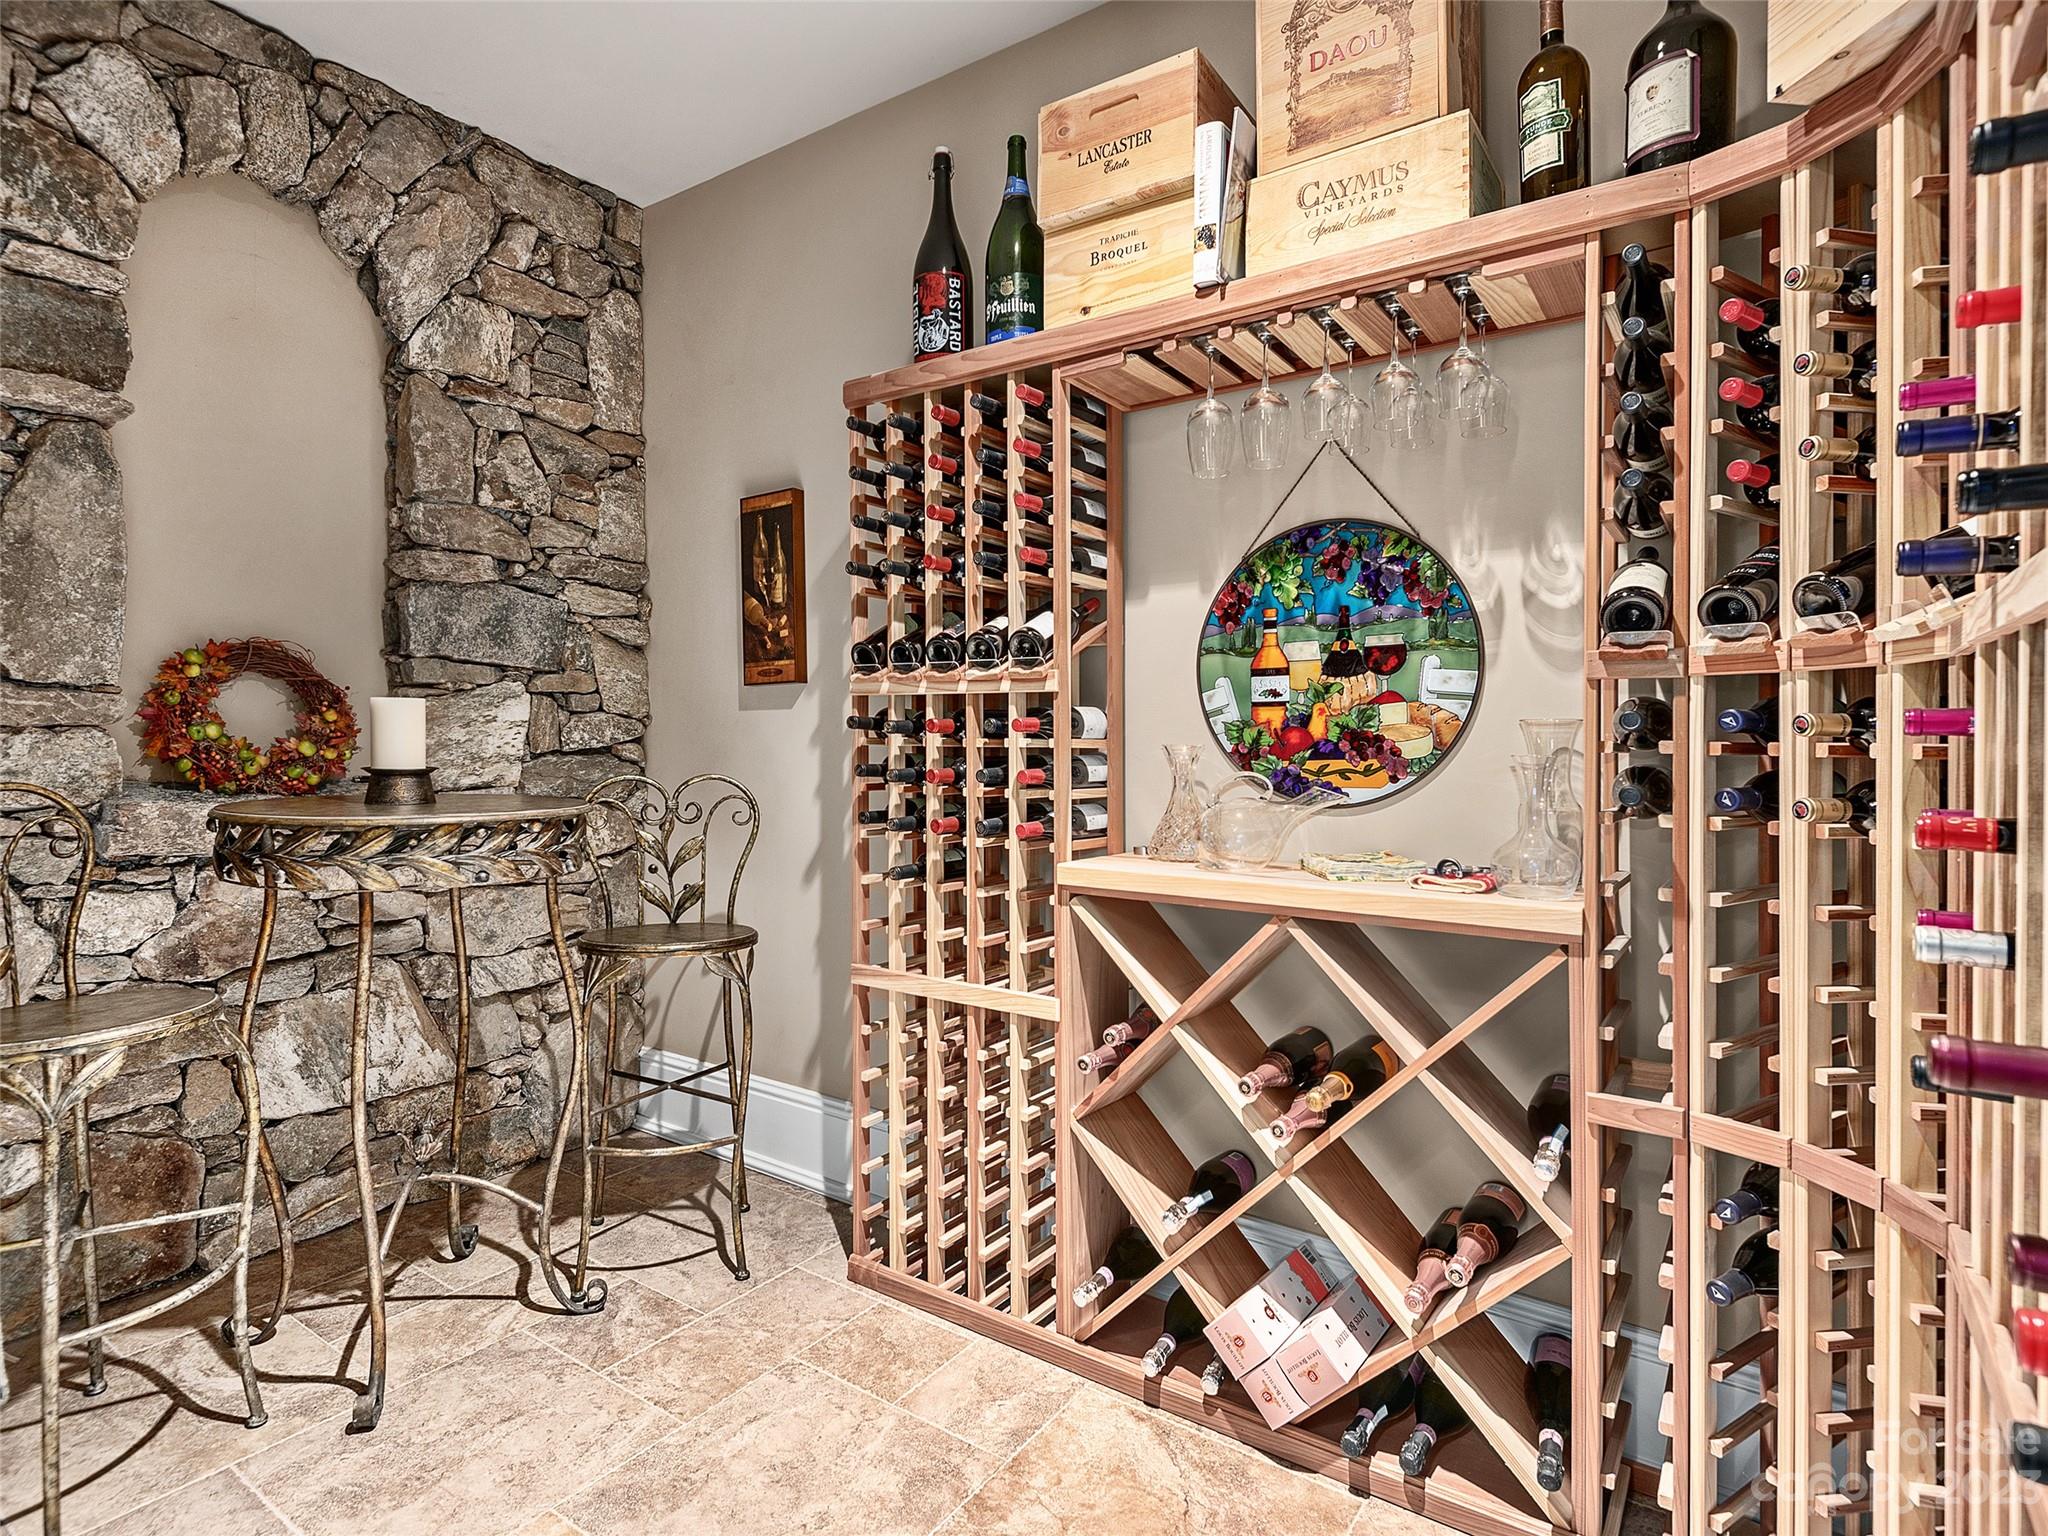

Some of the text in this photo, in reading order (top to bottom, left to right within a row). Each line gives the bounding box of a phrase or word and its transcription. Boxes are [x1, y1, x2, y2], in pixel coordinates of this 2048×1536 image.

[1309, 24, 1388, 73] DAOU
[1077, 128, 1152, 168] LANCASTER
[1103, 158, 1130, 174] Estate
[1296, 160, 1409, 211] CAYMUS
[1304, 184, 1404, 219] VINEYARDS
[1099, 228, 1140, 246] TRAPICHE
[1307, 206, 1397, 245] Special Selection
[948, 277, 961, 352] BASTARD
